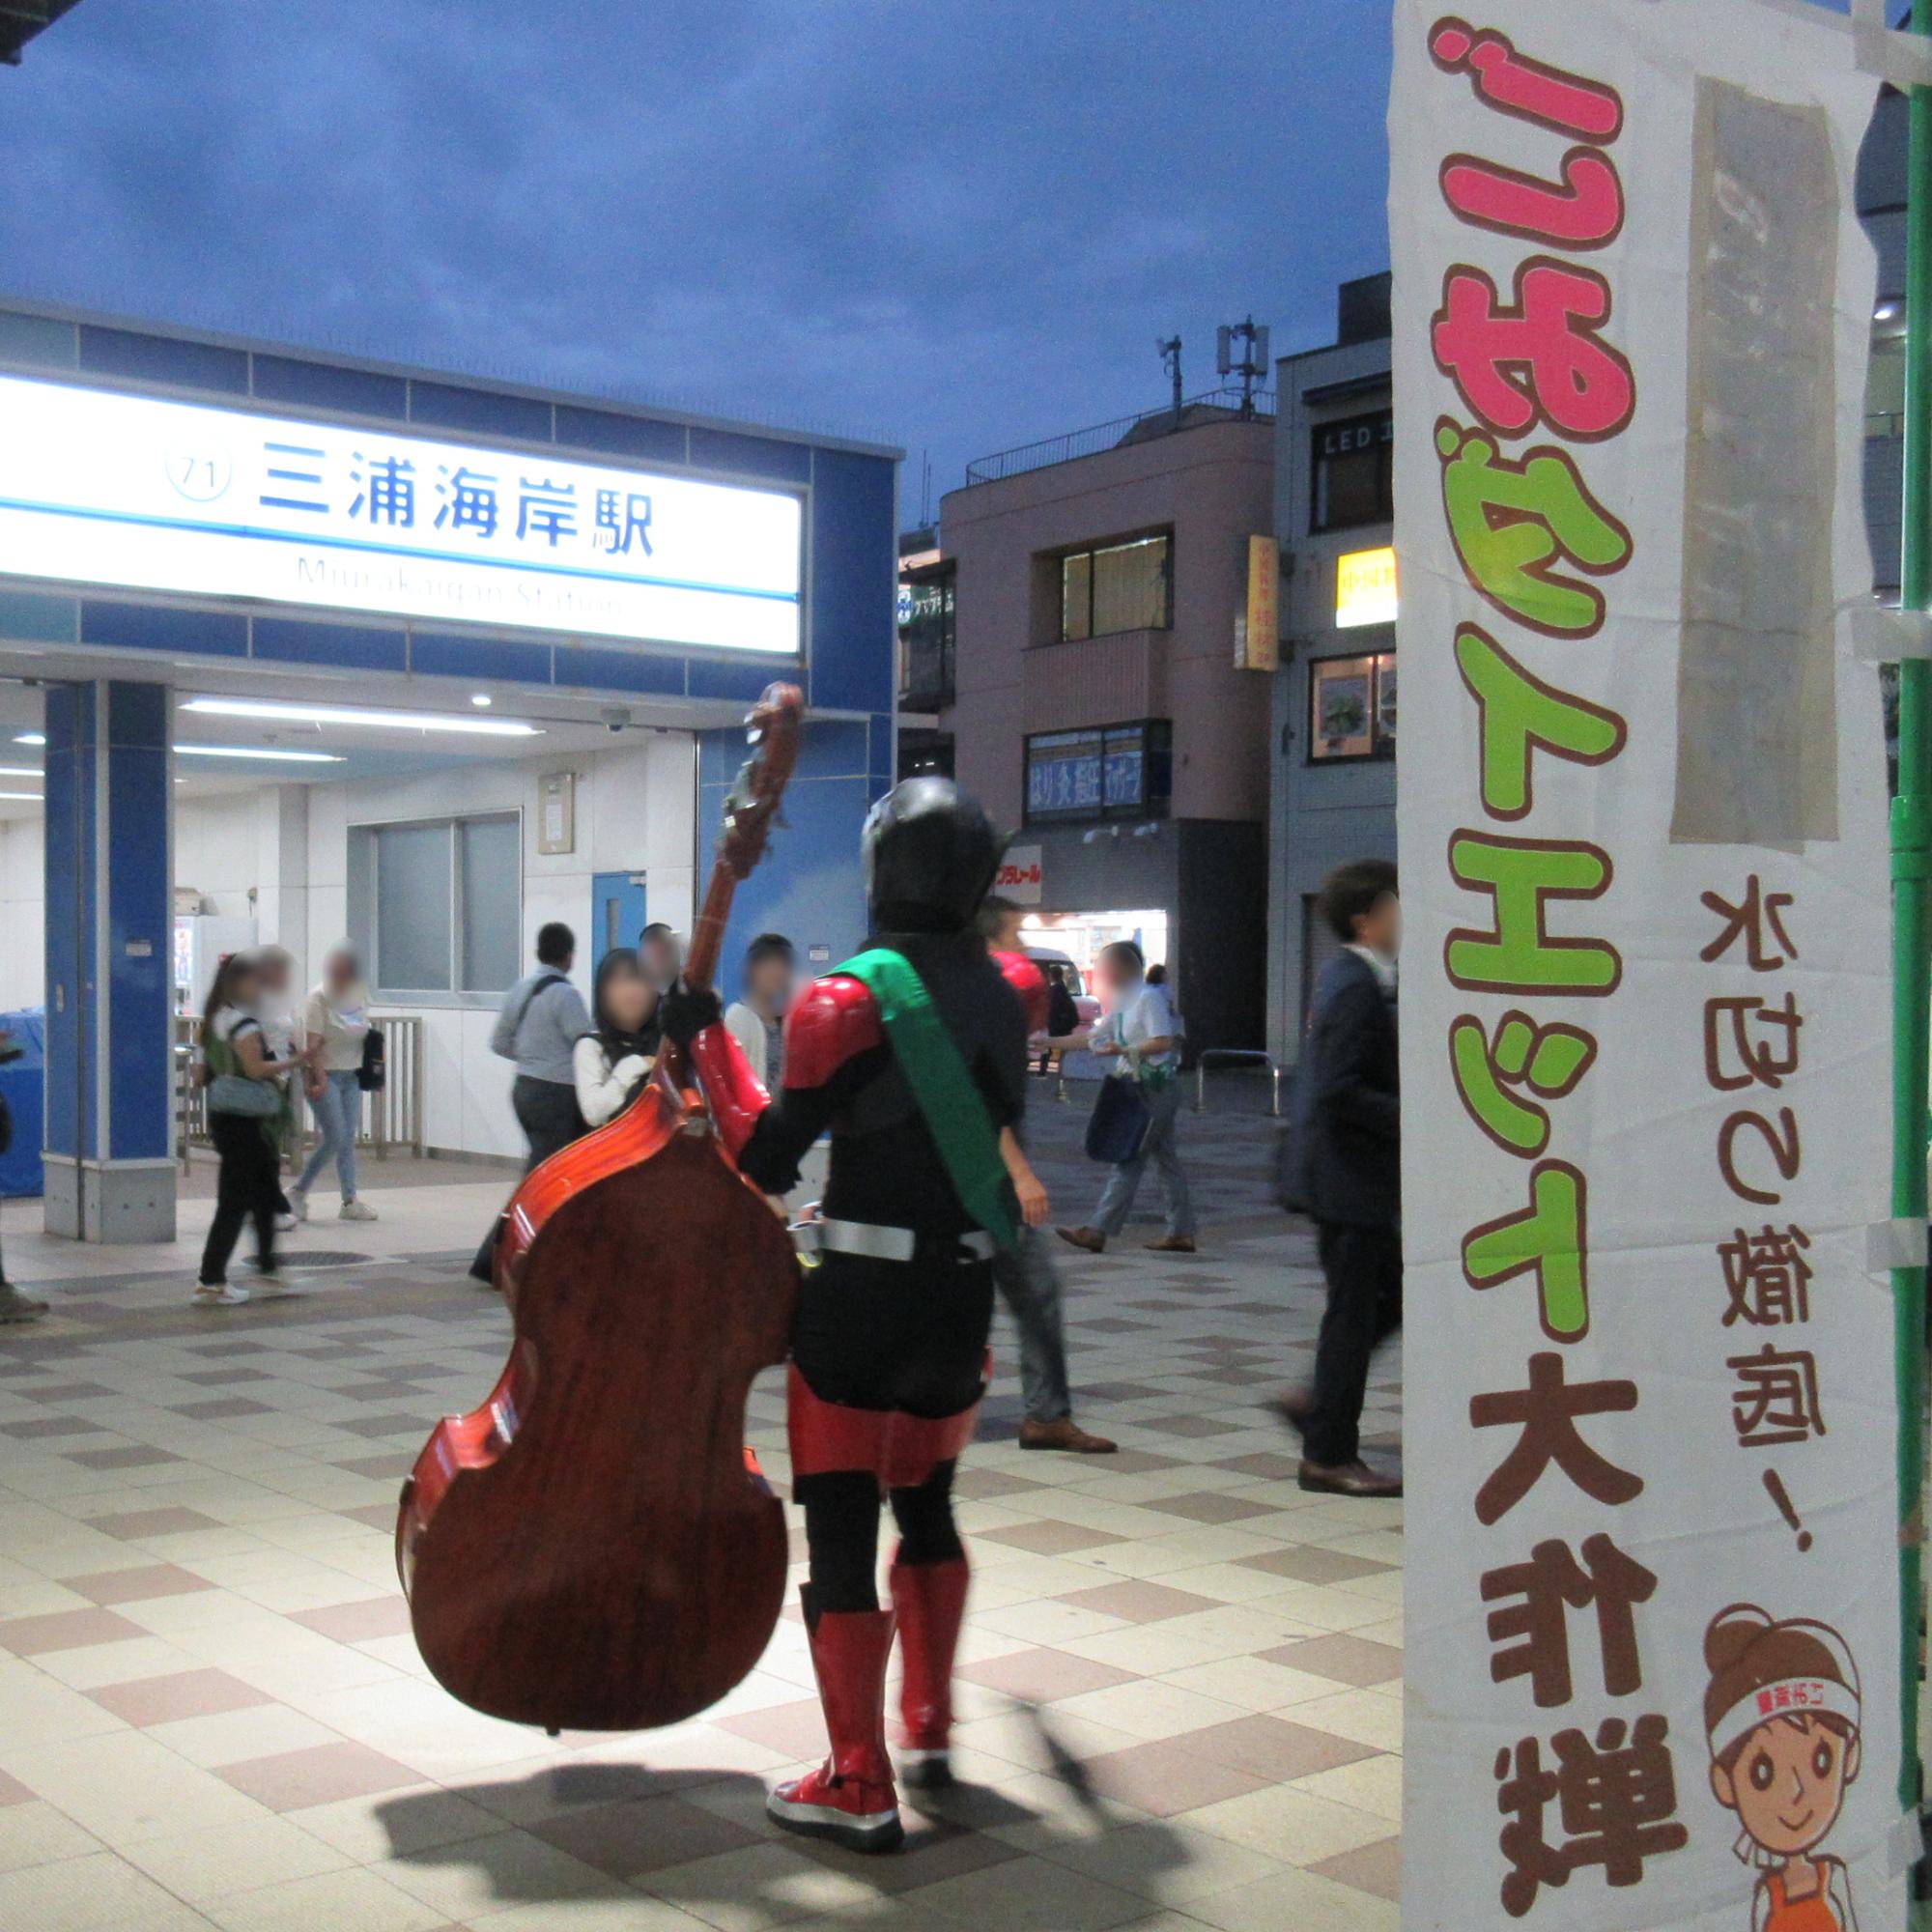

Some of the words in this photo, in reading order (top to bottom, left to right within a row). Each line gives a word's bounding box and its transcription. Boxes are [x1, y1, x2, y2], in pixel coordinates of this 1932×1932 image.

[1324, 427, 1371, 454] LED
[178, 455, 217, 489] 71
[259, 440, 655, 558] 三浦海岸駅
